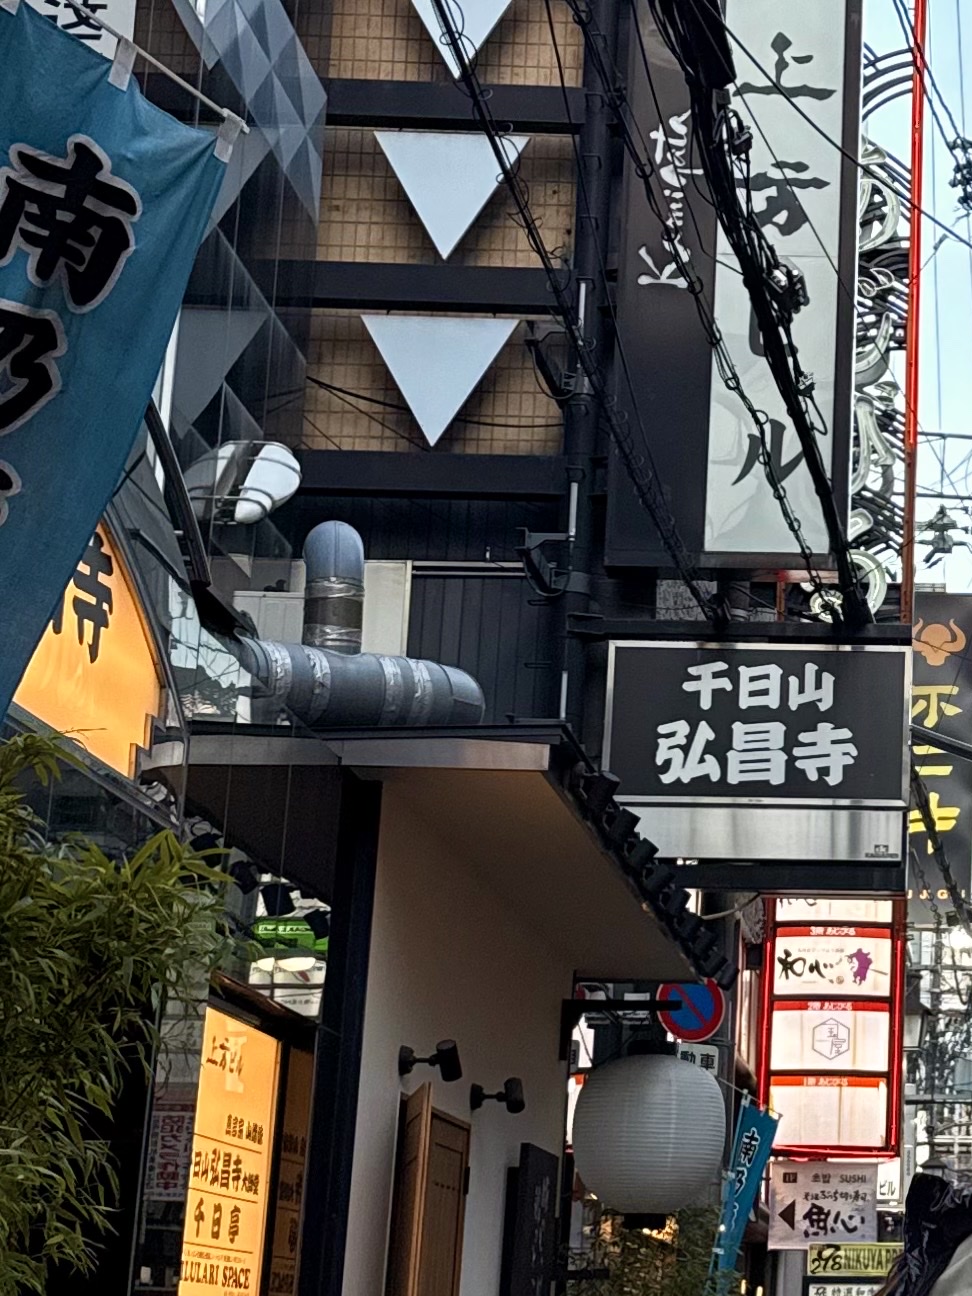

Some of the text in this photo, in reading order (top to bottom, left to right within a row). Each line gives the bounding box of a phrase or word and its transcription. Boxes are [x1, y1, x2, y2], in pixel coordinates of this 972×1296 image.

[682, 661, 835, 711] 千日山
[655, 720, 858, 786] 弘昌寺
[192, 1148, 243, 1193] 日山弘昌寺
[839, 1174, 867, 1183] SUSHI
[222, 1265, 251, 1290] SPACE
